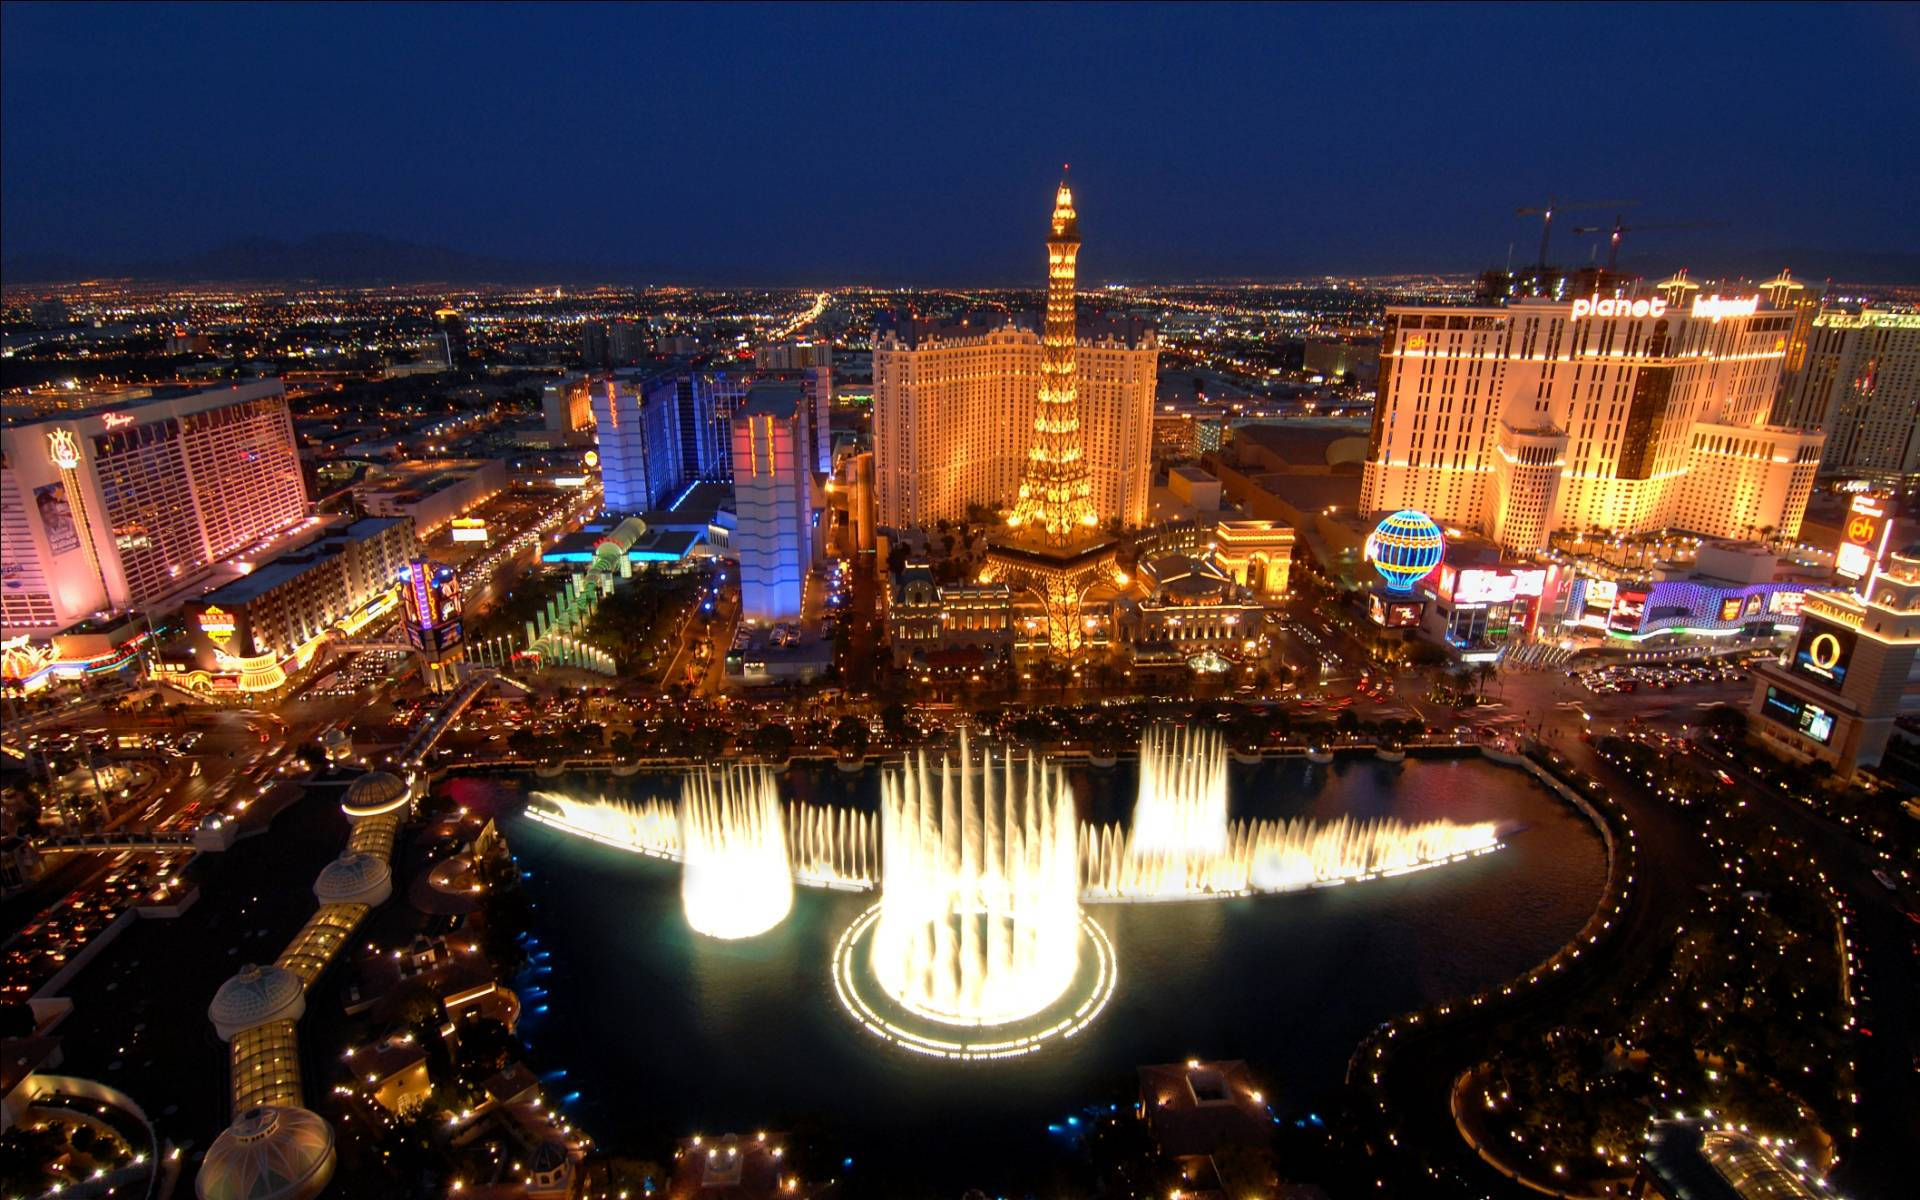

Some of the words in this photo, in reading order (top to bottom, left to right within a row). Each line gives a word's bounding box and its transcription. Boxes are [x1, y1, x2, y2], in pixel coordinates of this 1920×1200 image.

[1571, 293, 1667, 321] planet
[1851, 518, 1875, 541] ph
[1810, 633, 1841, 670] O
